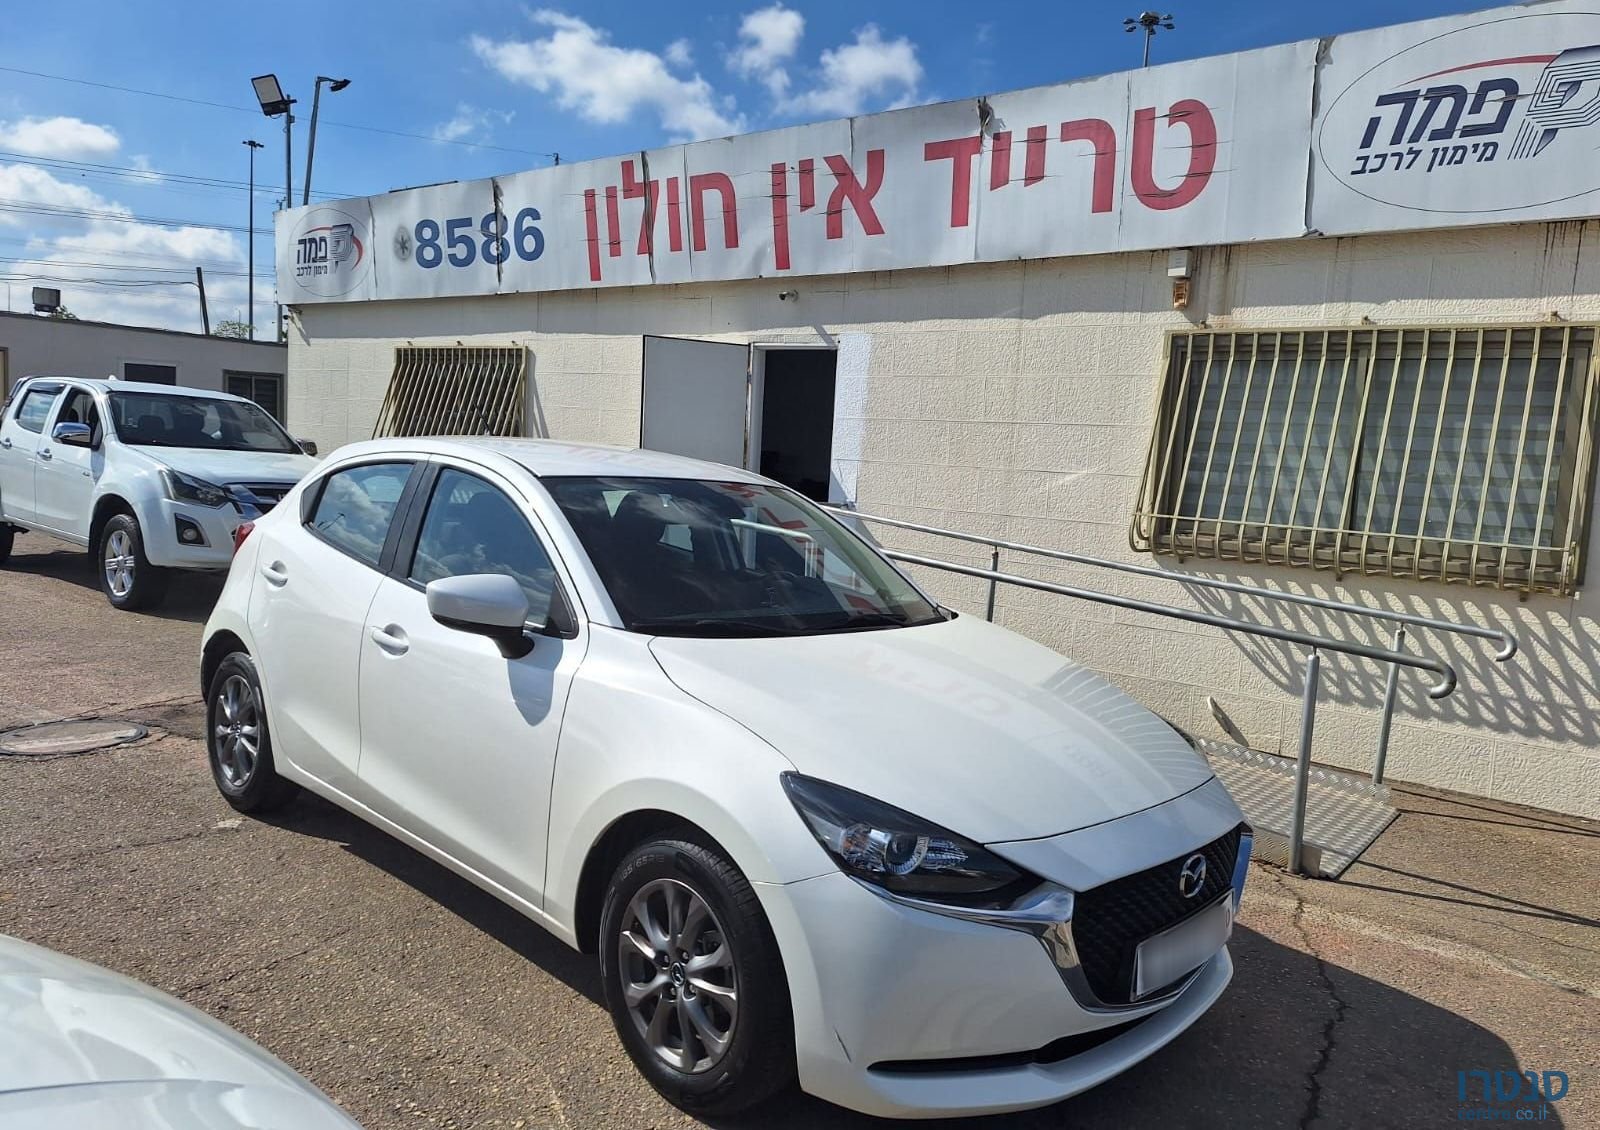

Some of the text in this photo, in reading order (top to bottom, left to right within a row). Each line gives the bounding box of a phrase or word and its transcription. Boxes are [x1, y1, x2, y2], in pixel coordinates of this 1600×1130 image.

[1359, 77, 1520, 150] פמה
[1350, 141, 1500, 176] מימון לרכב
[583, 98, 1218, 282] טרייד אין חולון
[296, 236, 329, 265] פמה
[296, 264, 312, 277] לרכב
